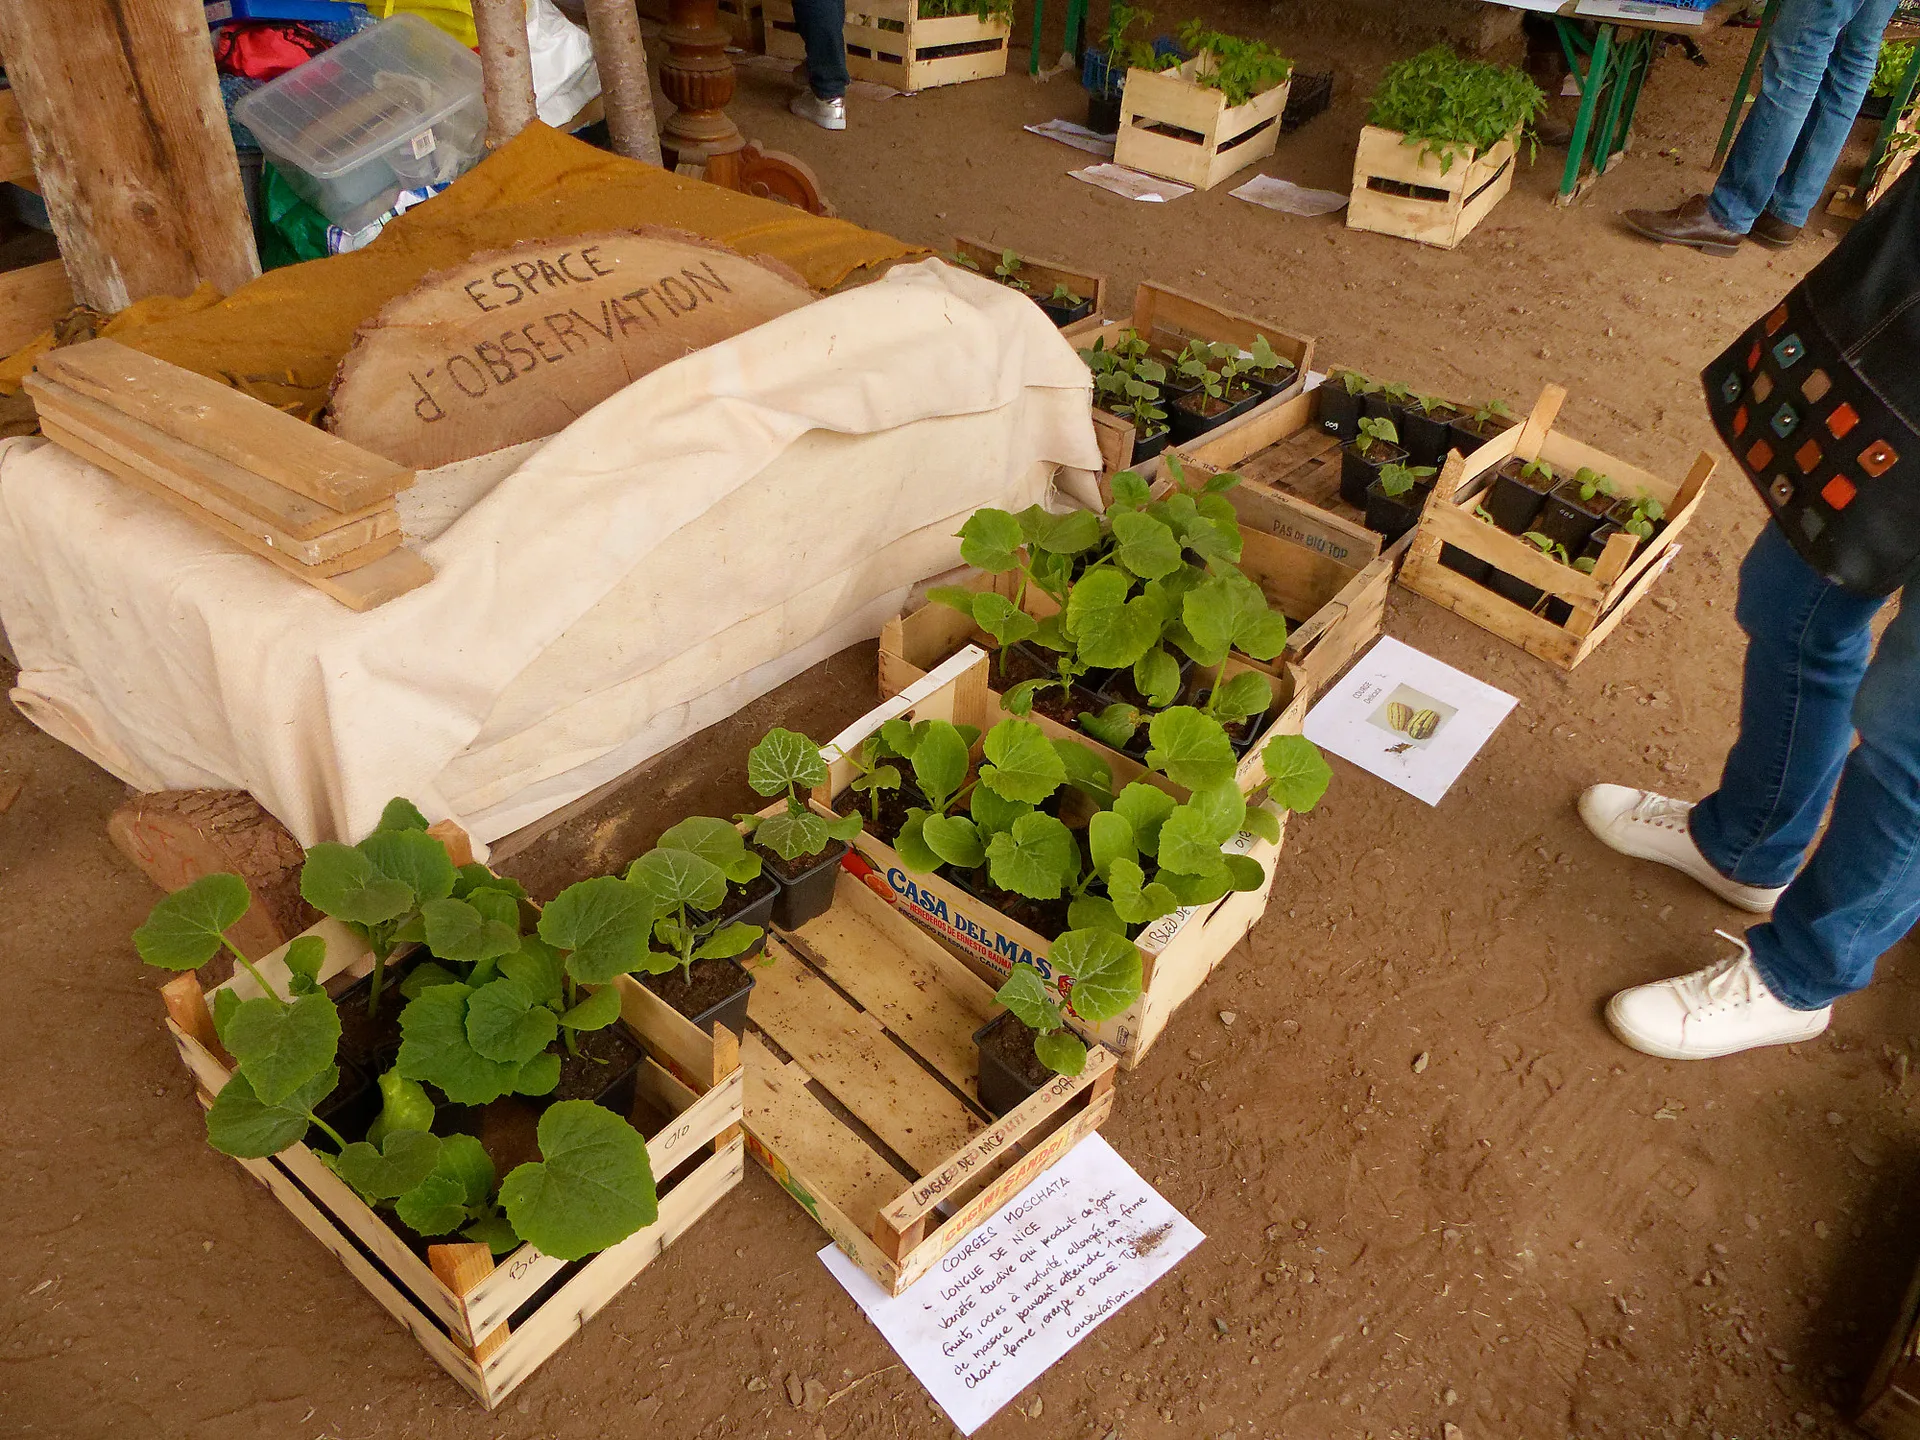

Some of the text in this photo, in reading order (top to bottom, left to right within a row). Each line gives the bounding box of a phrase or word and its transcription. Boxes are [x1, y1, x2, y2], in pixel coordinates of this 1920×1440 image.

[464, 245, 614, 313] ESPACE
[408, 260, 733, 423] d'OBSERVATION
[1272, 520, 1293, 538] PAS
[1294, 531, 1305, 541] DE
[1328, 543, 1349, 559] TOP
[1352, 681, 1372, 699] COURGE
[887, 867, 1053, 980] CASA DEL MAS
[898, 906, 938, 936] PRODUCIDO
[909, 903, 1013, 971] HEREDEROS DE ERNESTO BAUMA
[913, 1168, 954, 1206] LONGUE
[957, 1155, 975, 1172] DE
[942, 1177, 1070, 1273] COURGES MOSCHATA
[945, 1188, 1001, 1241] CUGINI
[940, 1264, 984, 1301] LONGUE
[989, 1246, 1008, 1261] DE
[980, 1263, 1017, 1295] tardive
[1019, 1246, 1038, 1263] qui
[1040, 1216, 1078, 1248] produit
[954, 1360, 971, 1376] de
[1015, 1284, 1058, 1325] pouvant
[1060, 1250, 1106, 1287] atteindre
[1008, 1292, 1020, 1304] à
[1076, 1283, 1086, 1297] et
